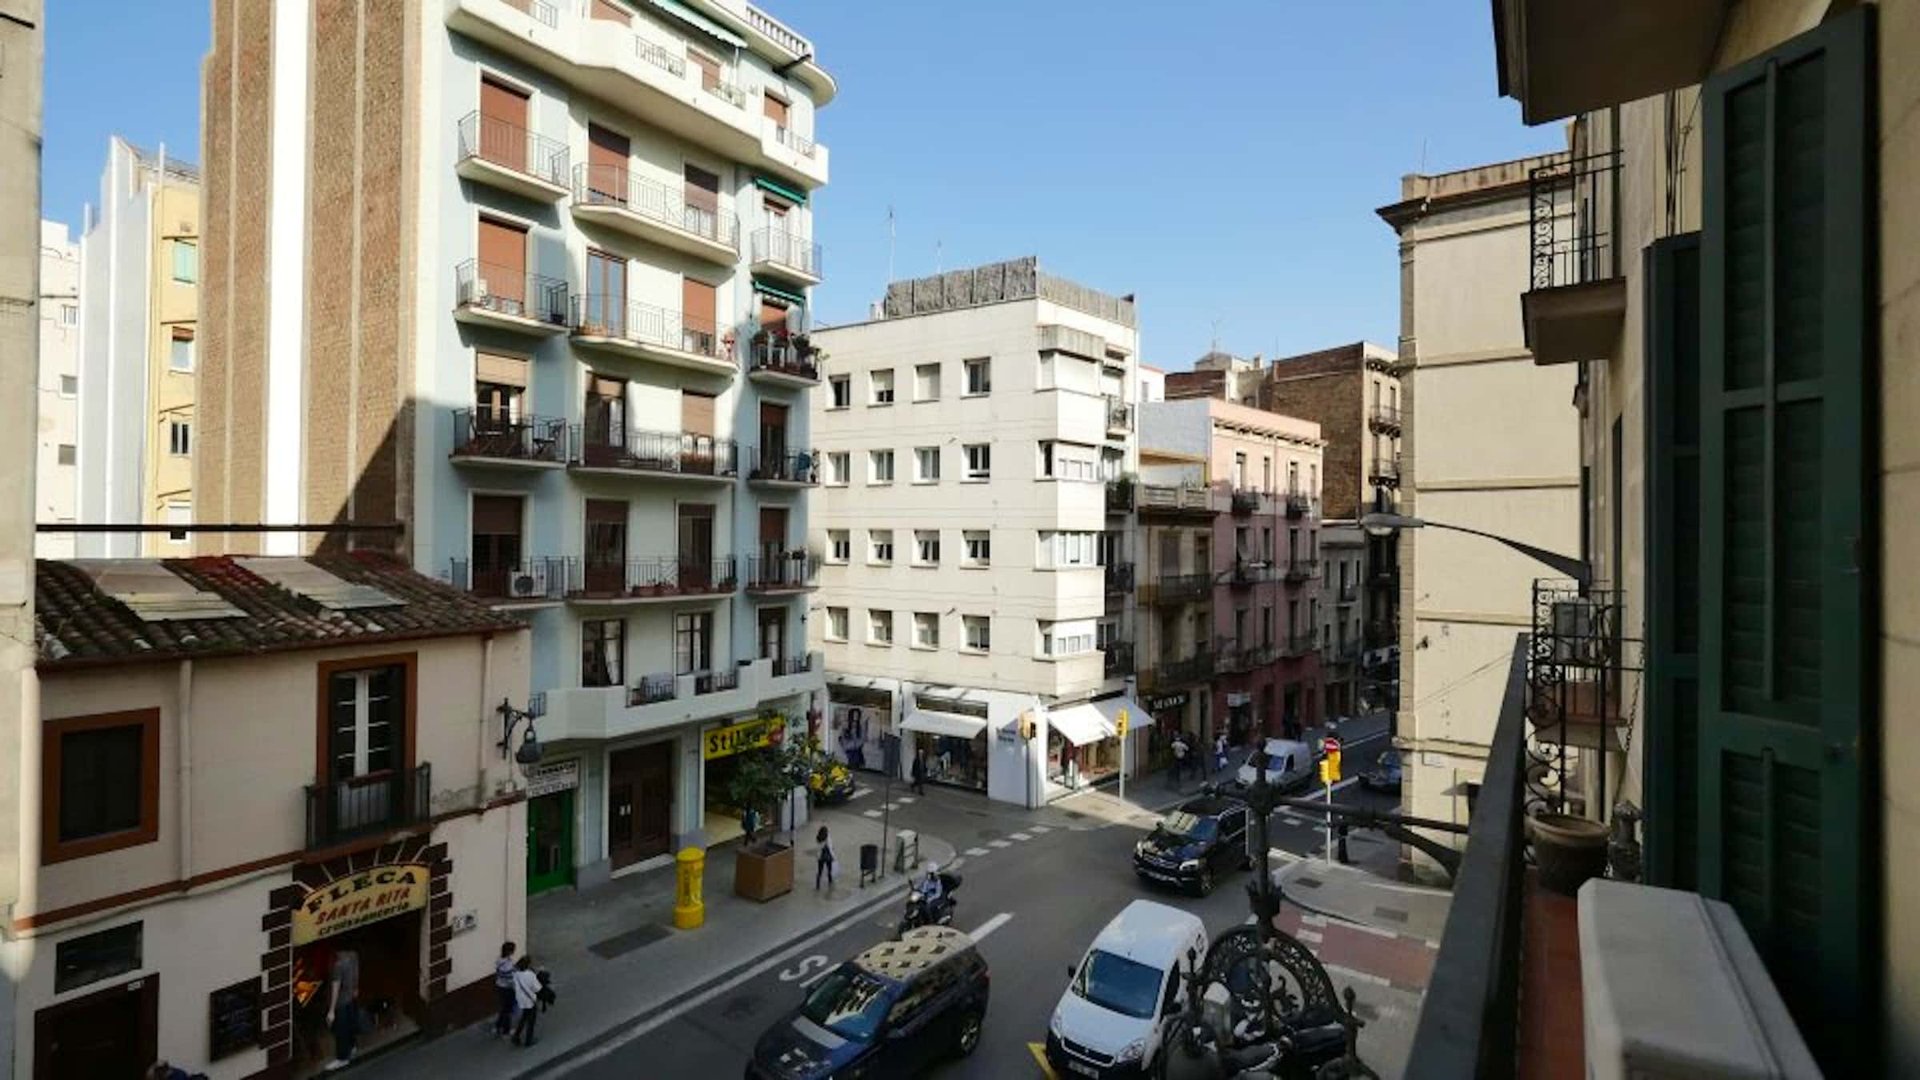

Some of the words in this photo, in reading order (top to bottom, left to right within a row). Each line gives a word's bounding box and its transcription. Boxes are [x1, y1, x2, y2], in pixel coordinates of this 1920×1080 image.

[306, 871, 417, 914] FLECA
[315, 897, 371, 925] SANTA
[375, 887, 411, 907] RITA
